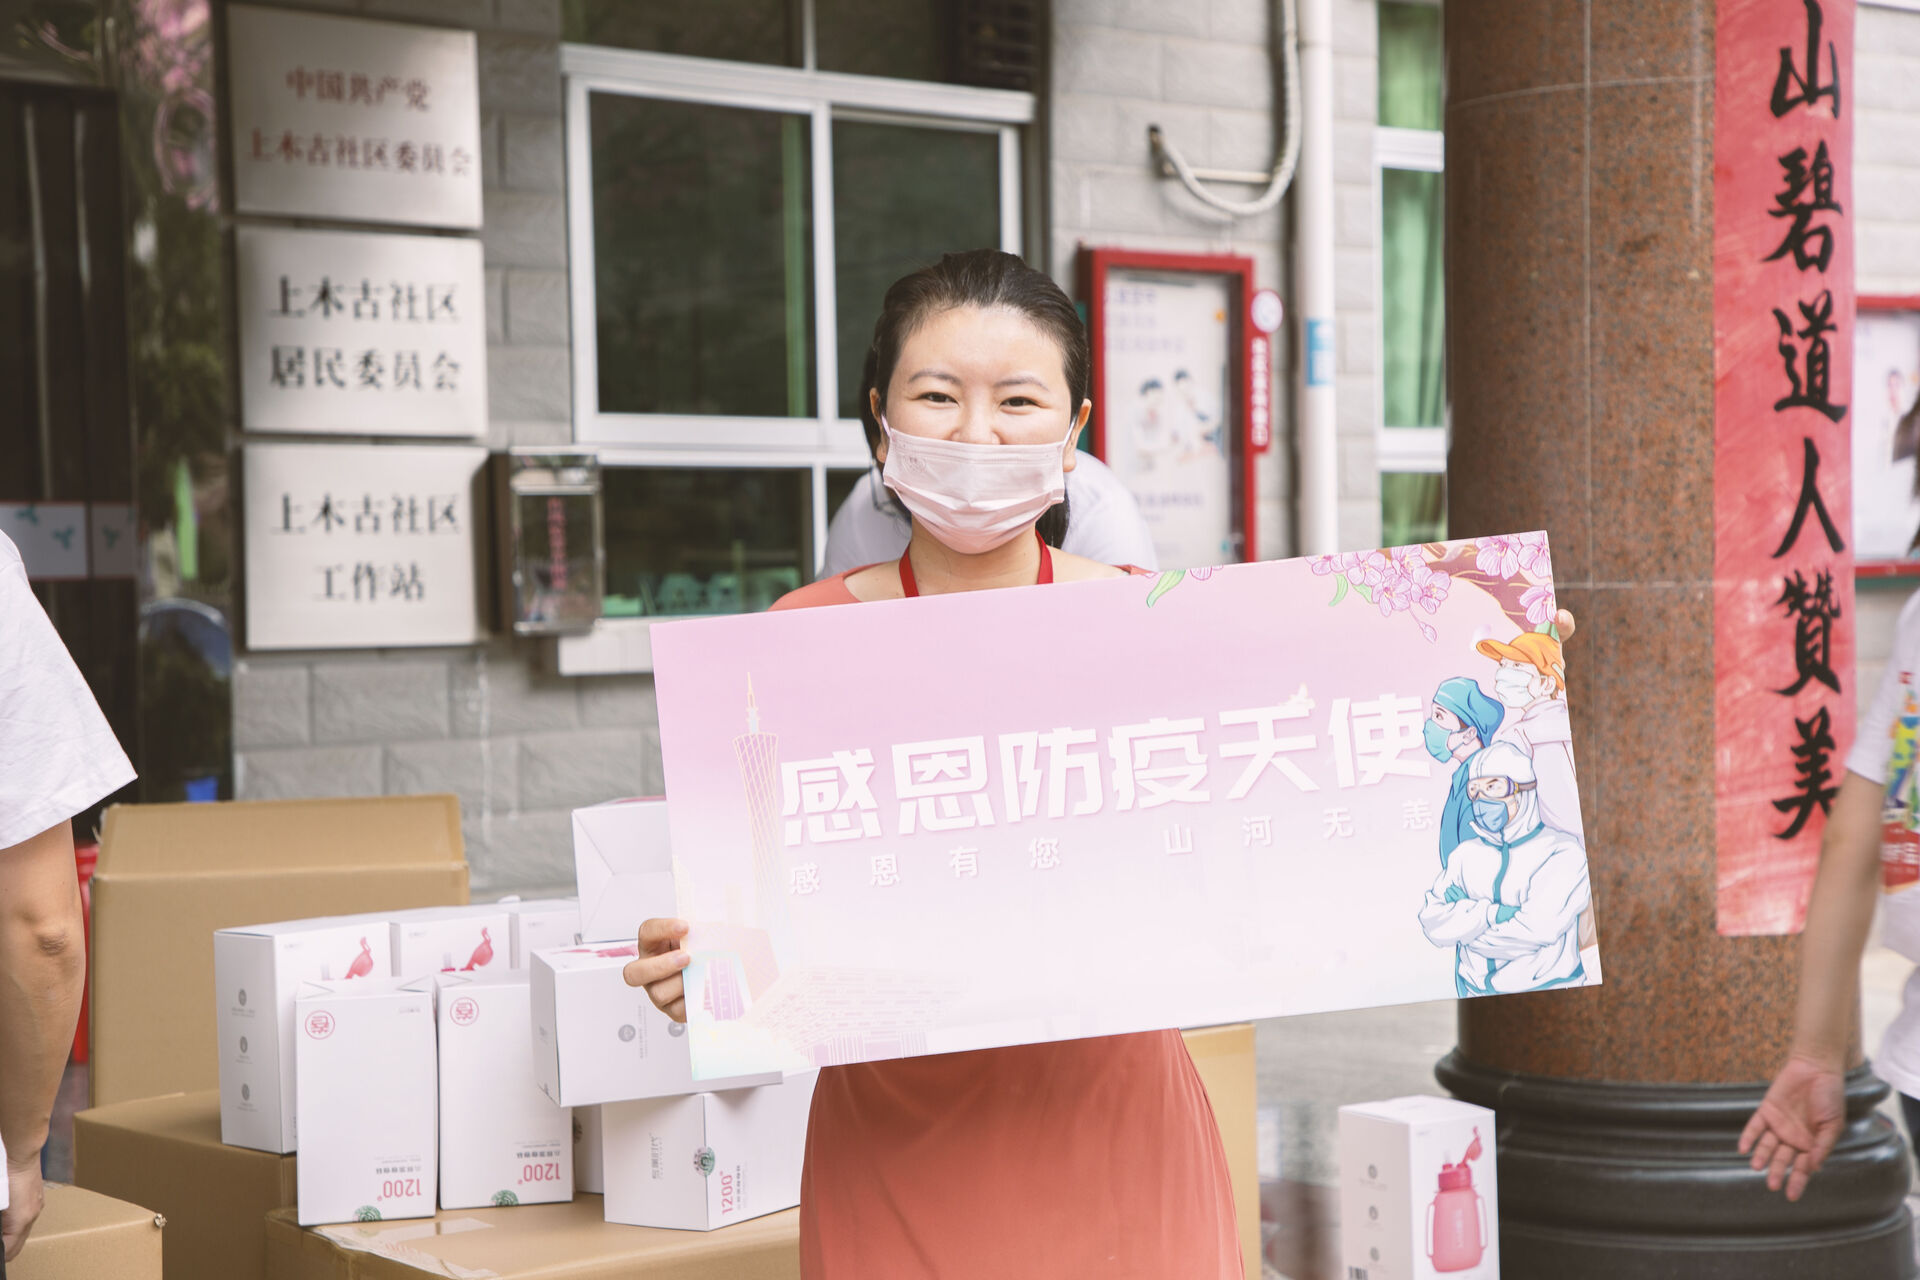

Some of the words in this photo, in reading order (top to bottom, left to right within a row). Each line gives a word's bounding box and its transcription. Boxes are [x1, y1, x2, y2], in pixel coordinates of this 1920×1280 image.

[285, 66, 430, 112] 中国共产党
[250, 128, 472, 178] 上木古社区委员会
[268, 274, 459, 322] 上木古社区
[271, 344, 462, 390] 居民委员会
[270, 493, 461, 535] 上木古社区
[312, 562, 426, 602] 工作站
[780, 693, 1431, 847] 感恩防疫天使
[788, 836, 1061, 895] 感恩有您
[1163, 798, 1434, 856] 山河无恙
